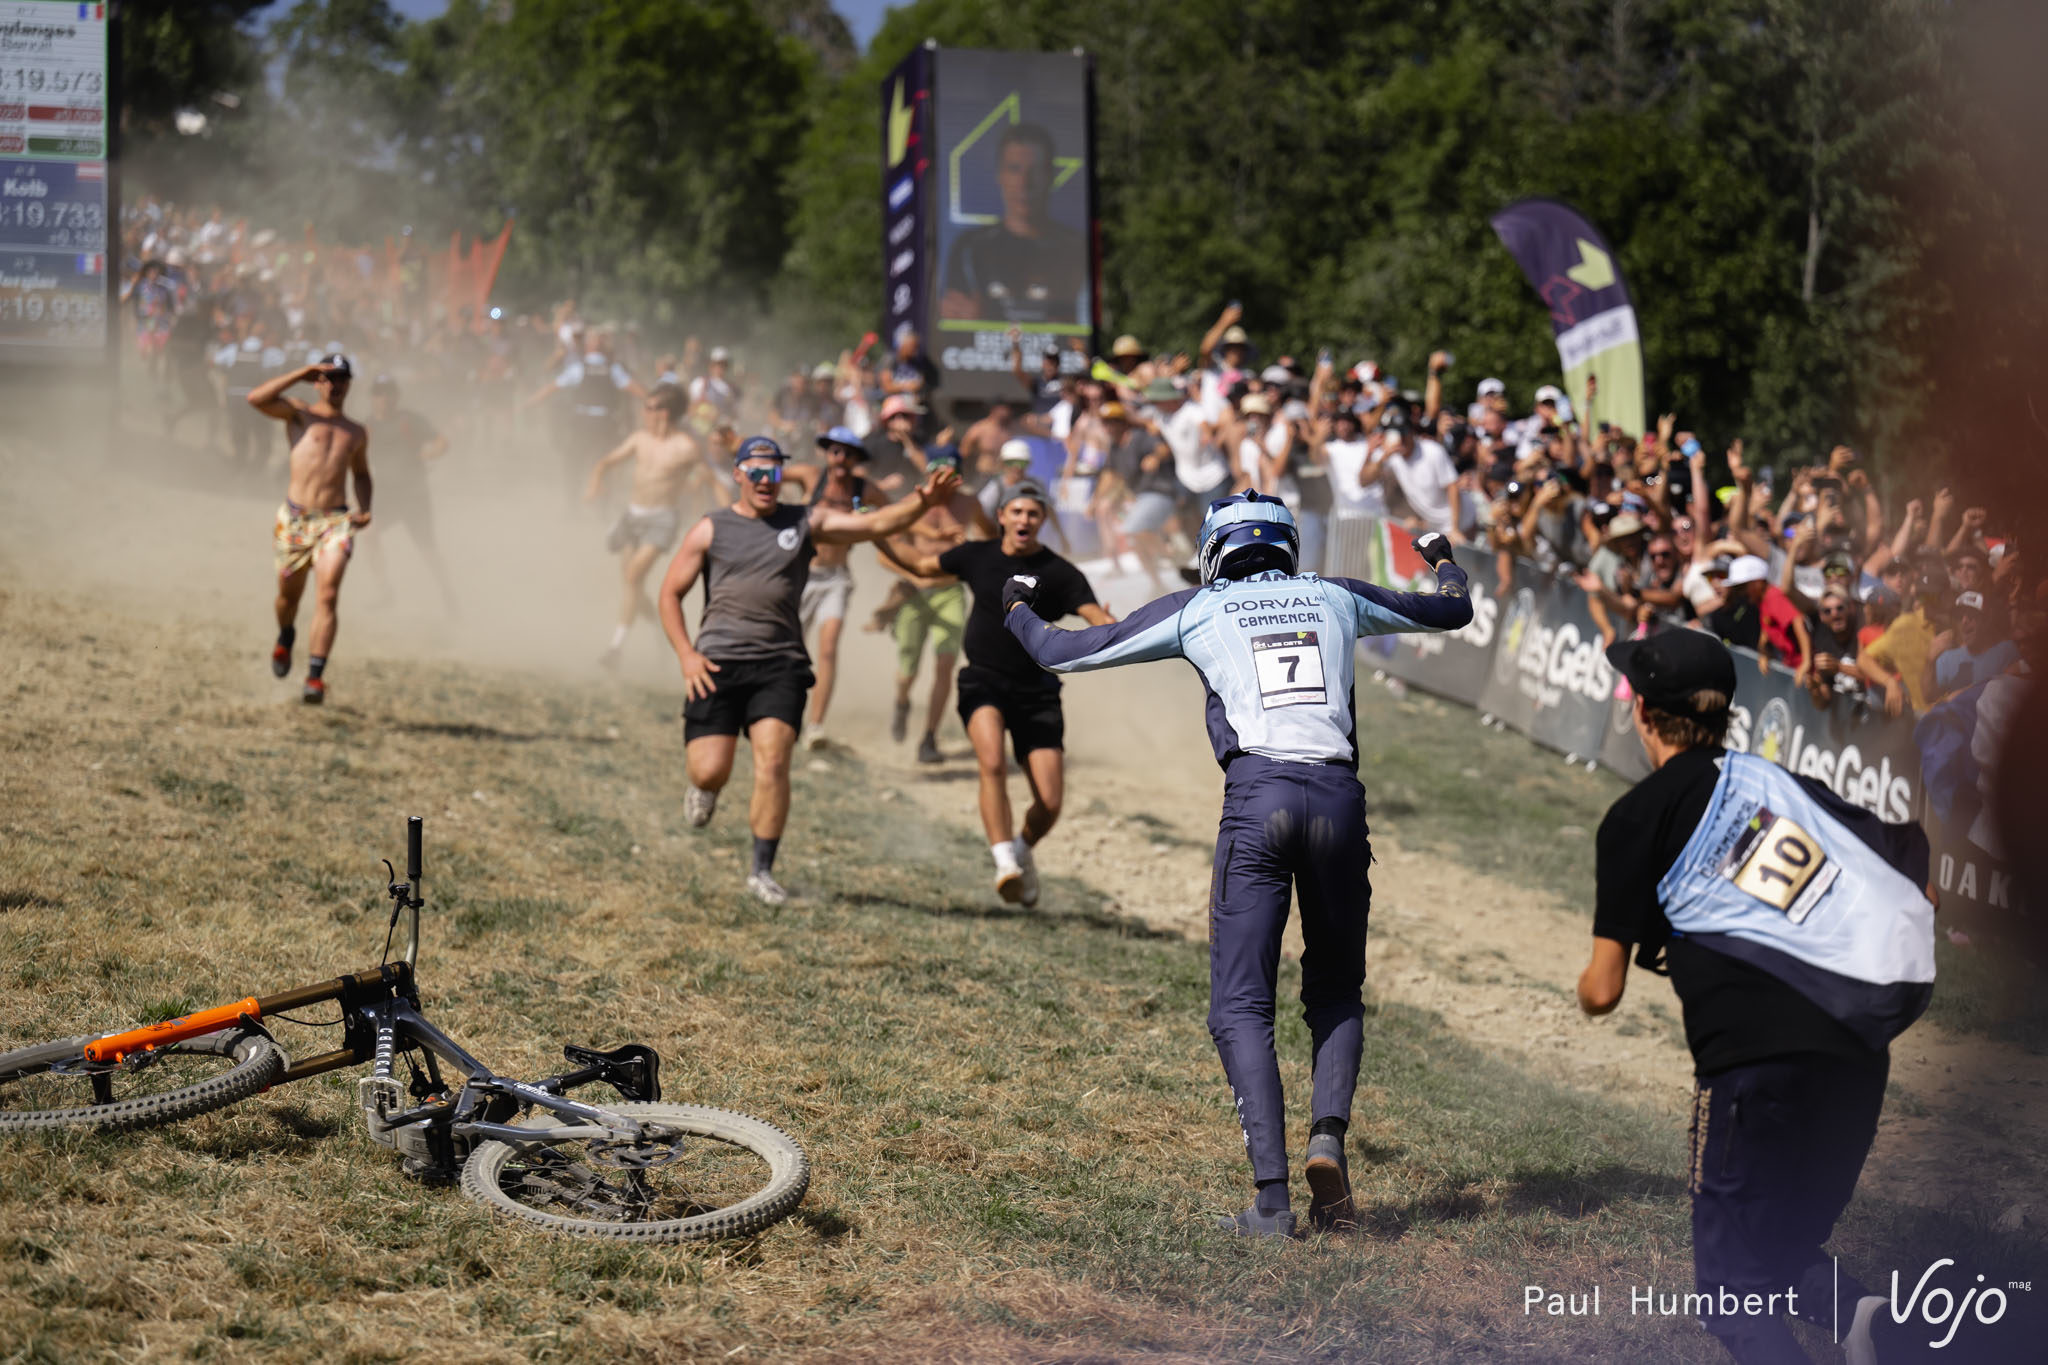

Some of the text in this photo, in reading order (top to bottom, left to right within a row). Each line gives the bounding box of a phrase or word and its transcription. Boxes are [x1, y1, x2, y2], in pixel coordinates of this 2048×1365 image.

[0, 68, 102, 94] :19.573
[0, 200, 102, 228] :19.733
[1224, 597, 1320, 613] DORVAL
[1278, 655, 1300, 683] 7
[1758, 836, 1812, 887] 10
